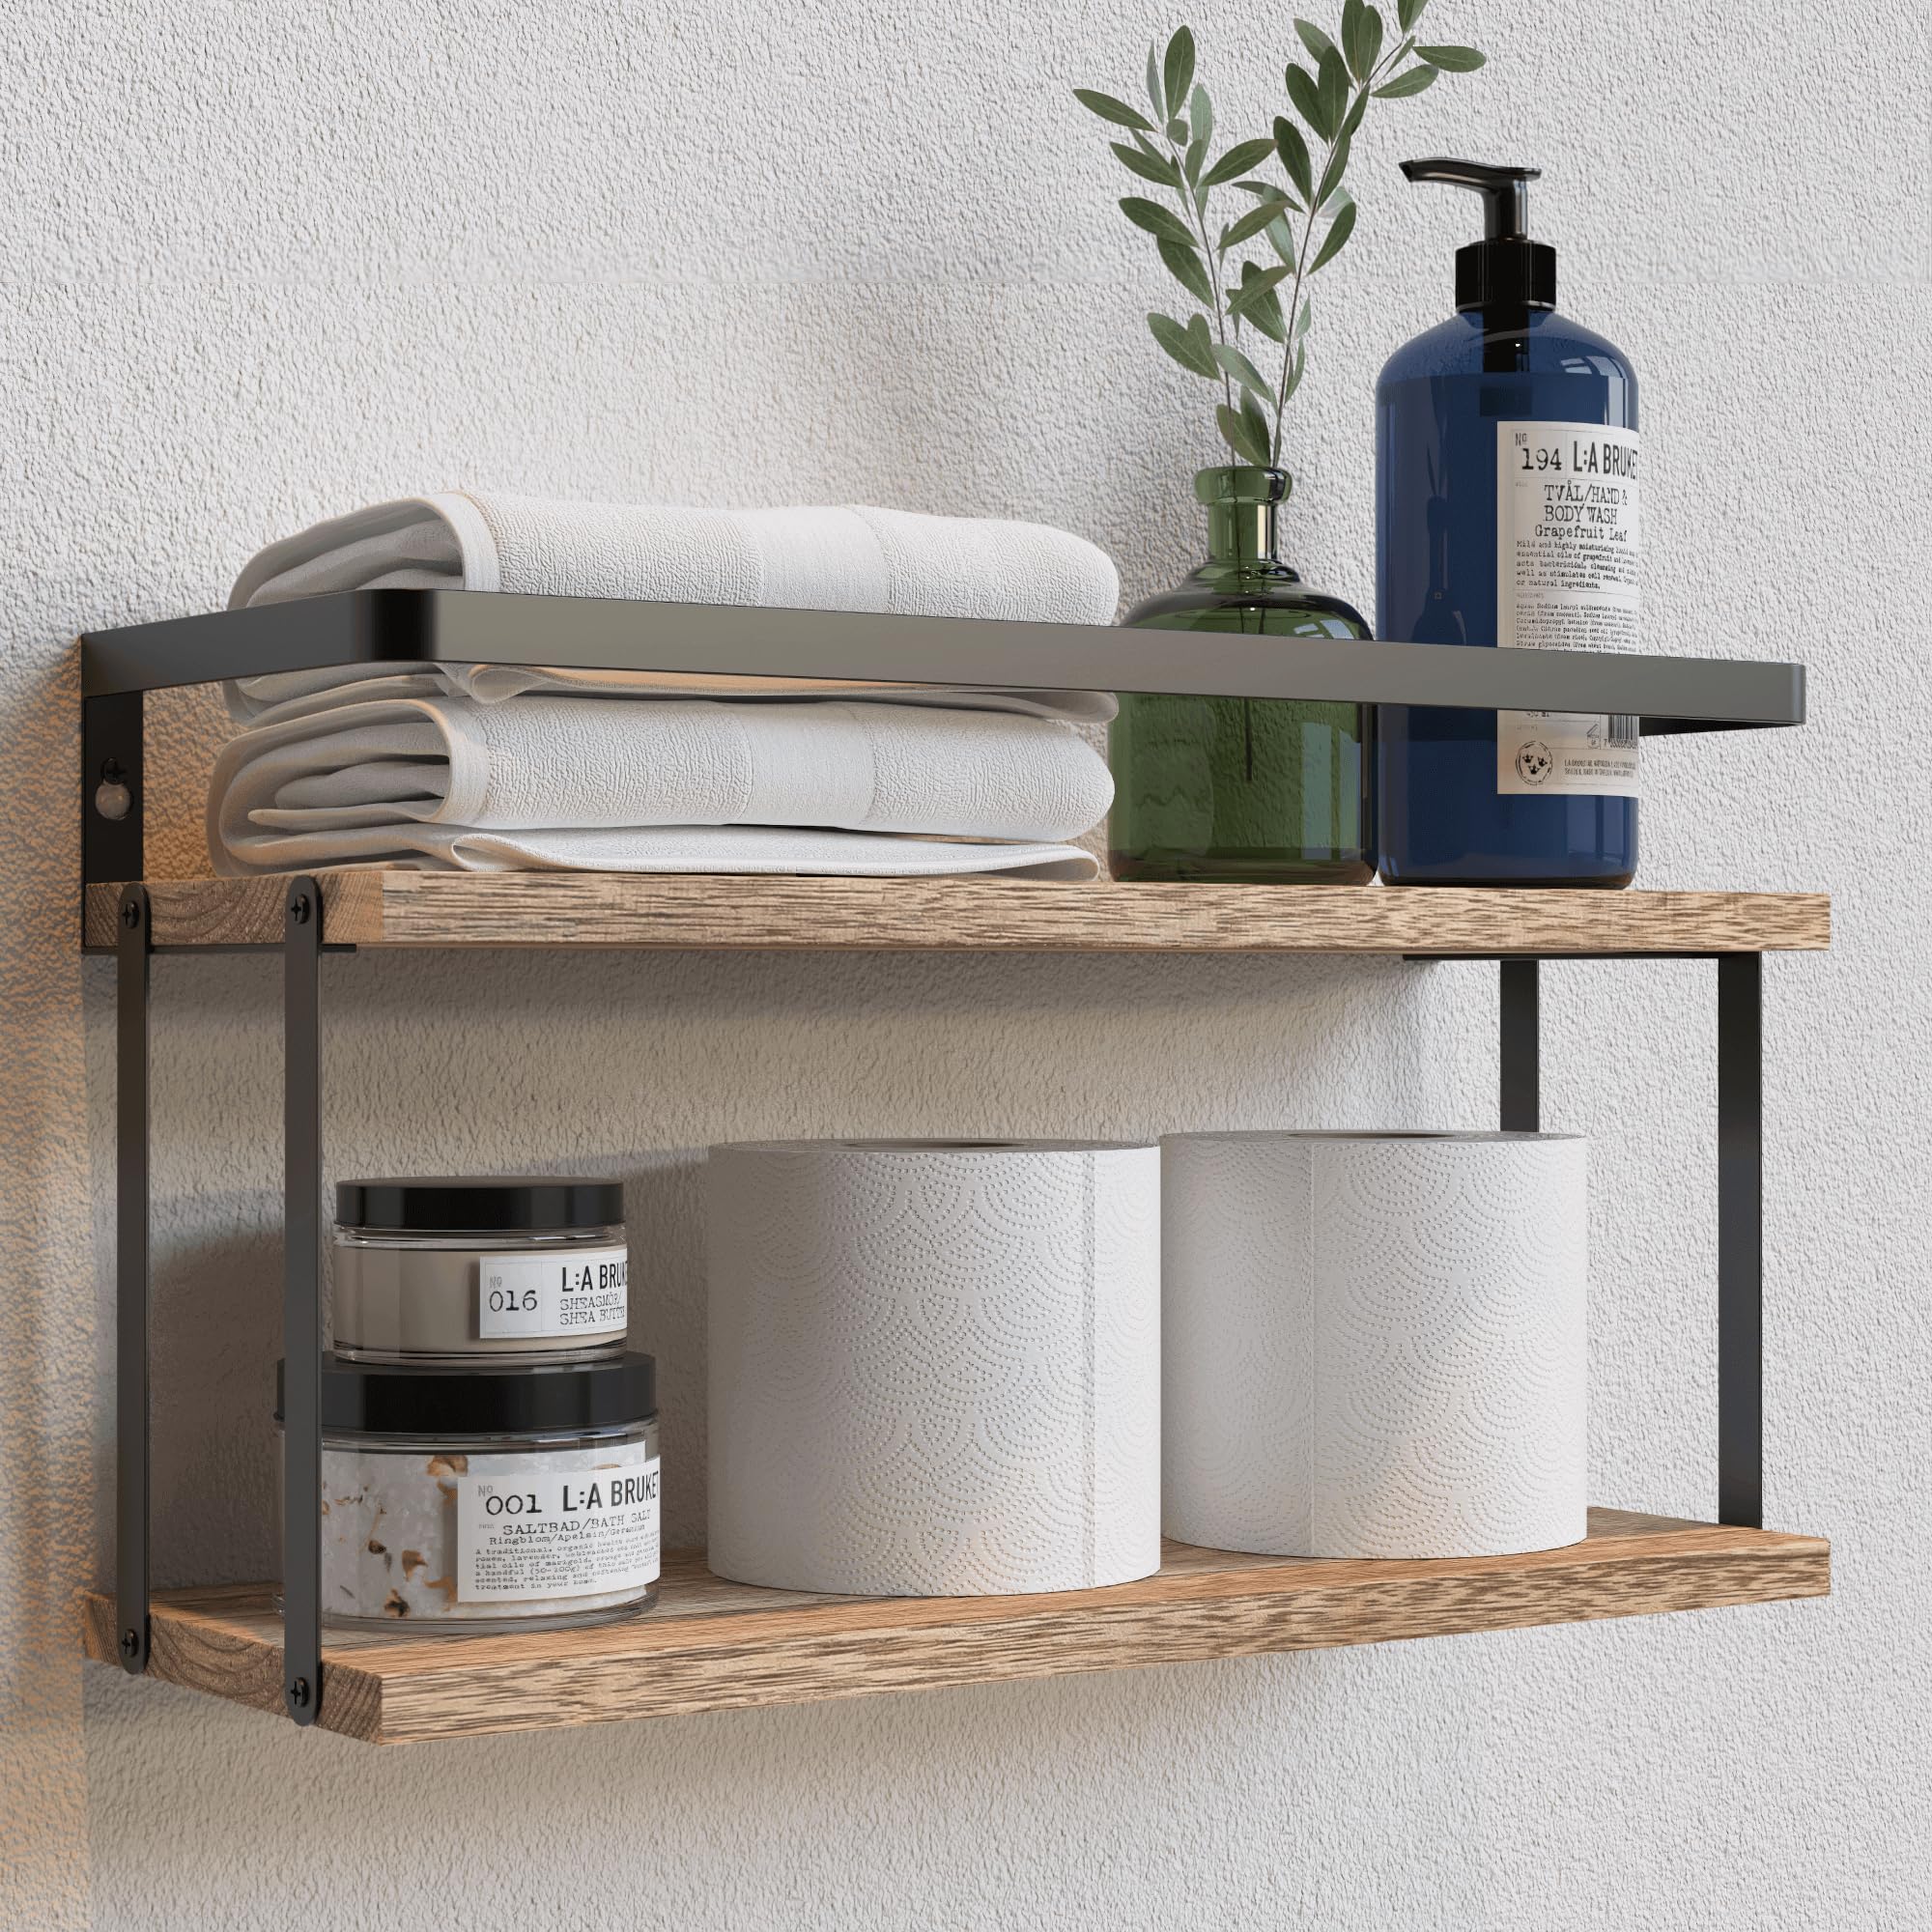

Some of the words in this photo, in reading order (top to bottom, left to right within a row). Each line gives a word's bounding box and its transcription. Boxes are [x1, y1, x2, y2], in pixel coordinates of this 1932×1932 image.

[1521, 447, 1562, 470] 194
[1574, 440, 1599, 473] L:A
[1544, 480, 1620, 505] TVÅL/HAND
[1544, 503, 1584, 523] BODY
[1586, 506, 1618, 525] WASH
[1535, 525, 1604, 540] Grapefruit
[1609, 527, 1627, 542] Leaf
[489, 1290, 537, 1312] 016
[562, 1265, 593, 1293] L:A
[559, 1311, 595, 1325] SHEA
[485, 1493, 542, 1516] 001
[562, 1482, 603, 1512] L:A
[611, 1470, 659, 1507] BRUKET
[503, 1515, 625, 1536] SALTBAD/BATH
[631, 1509, 651, 1523] SALT
